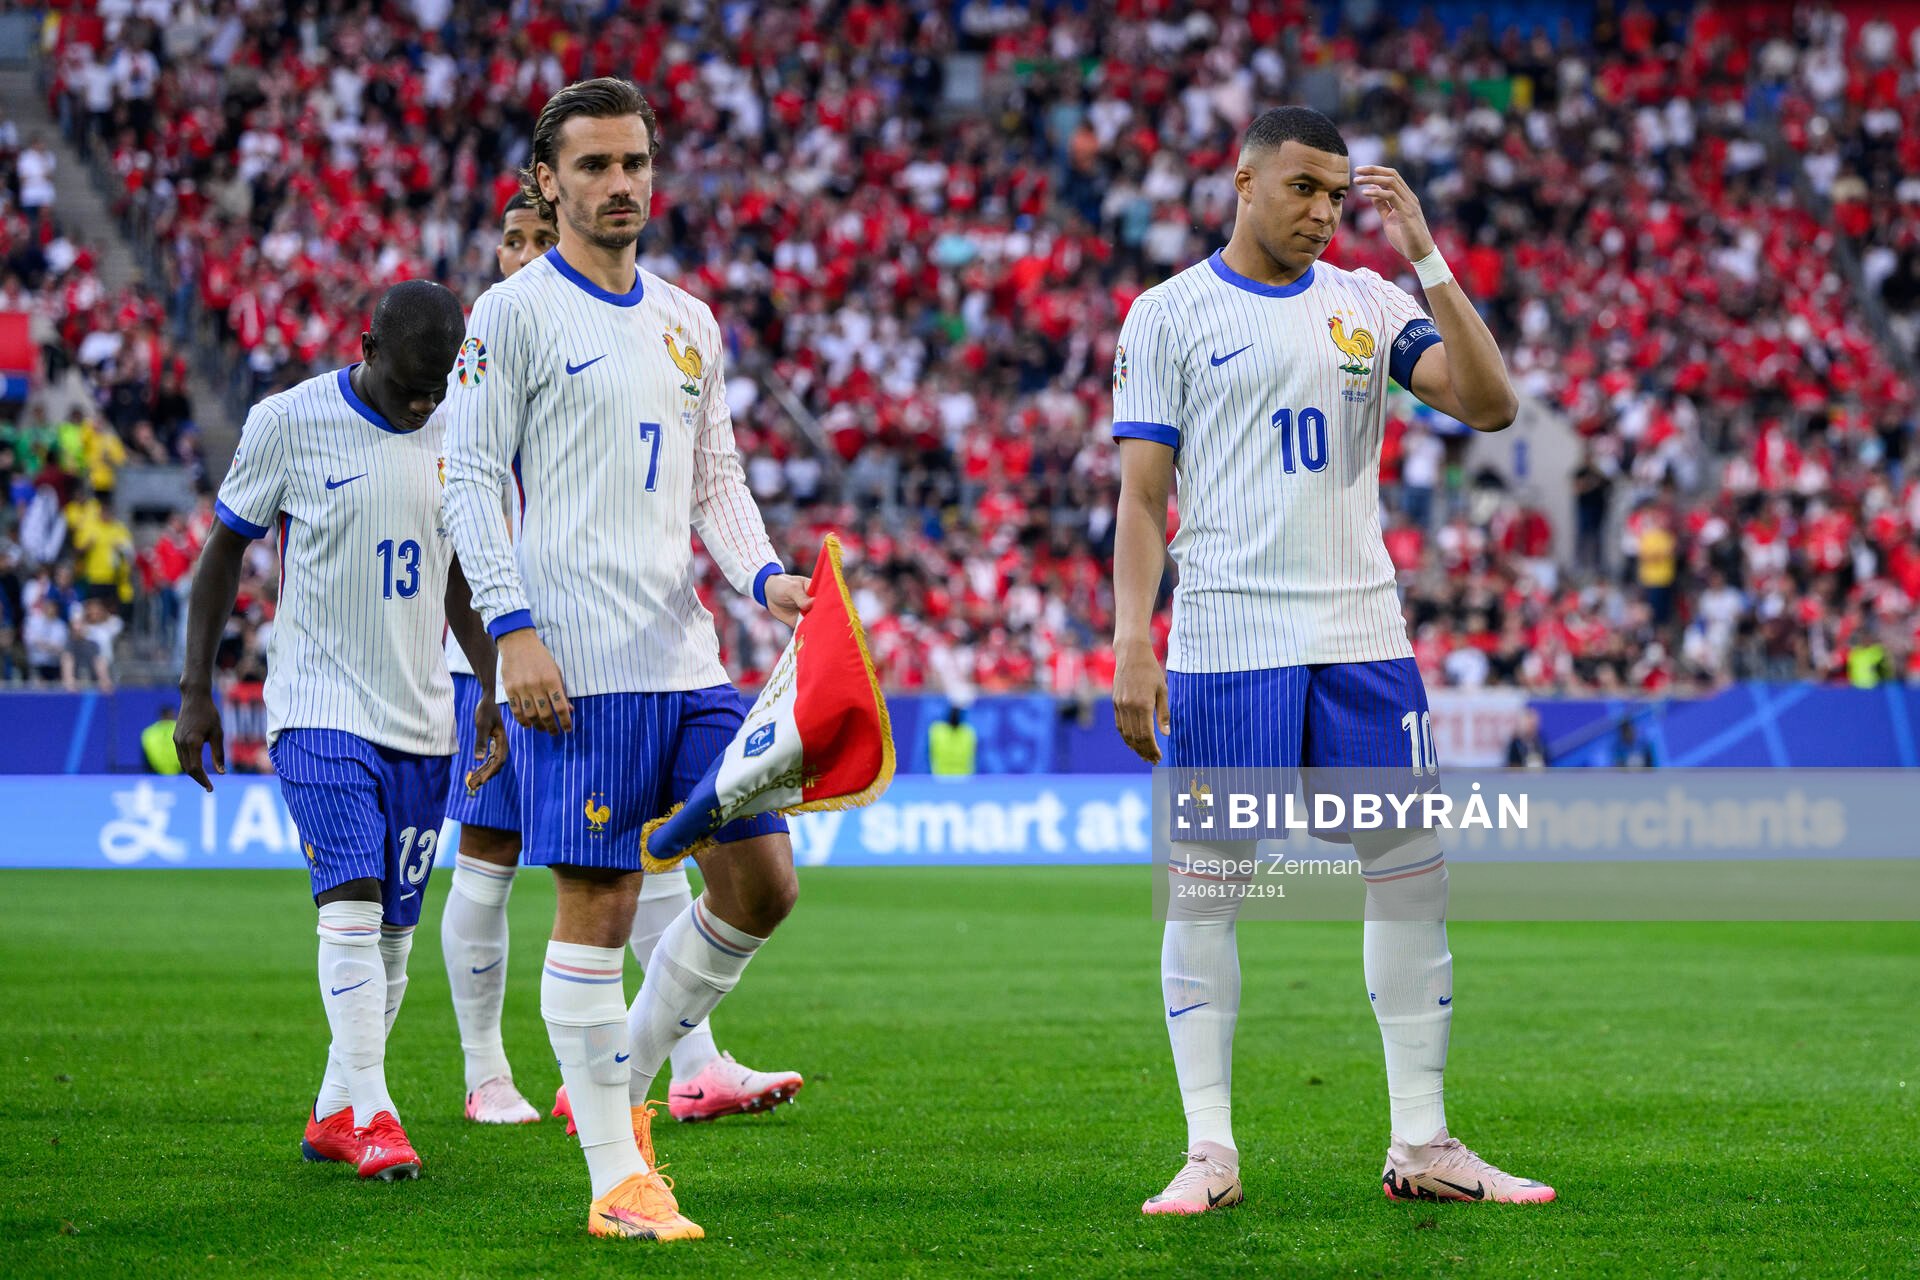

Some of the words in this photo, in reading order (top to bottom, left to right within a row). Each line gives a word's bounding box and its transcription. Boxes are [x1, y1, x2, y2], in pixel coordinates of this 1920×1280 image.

[639, 422, 663, 492] 7
[1271, 407, 1329, 474] 10
[377, 539, 421, 600] 13
[1401, 711, 1437, 776] 10
[860, 791, 1066, 853] smart
[1076, 791, 1147, 853] at
[399, 826, 438, 885] 13
